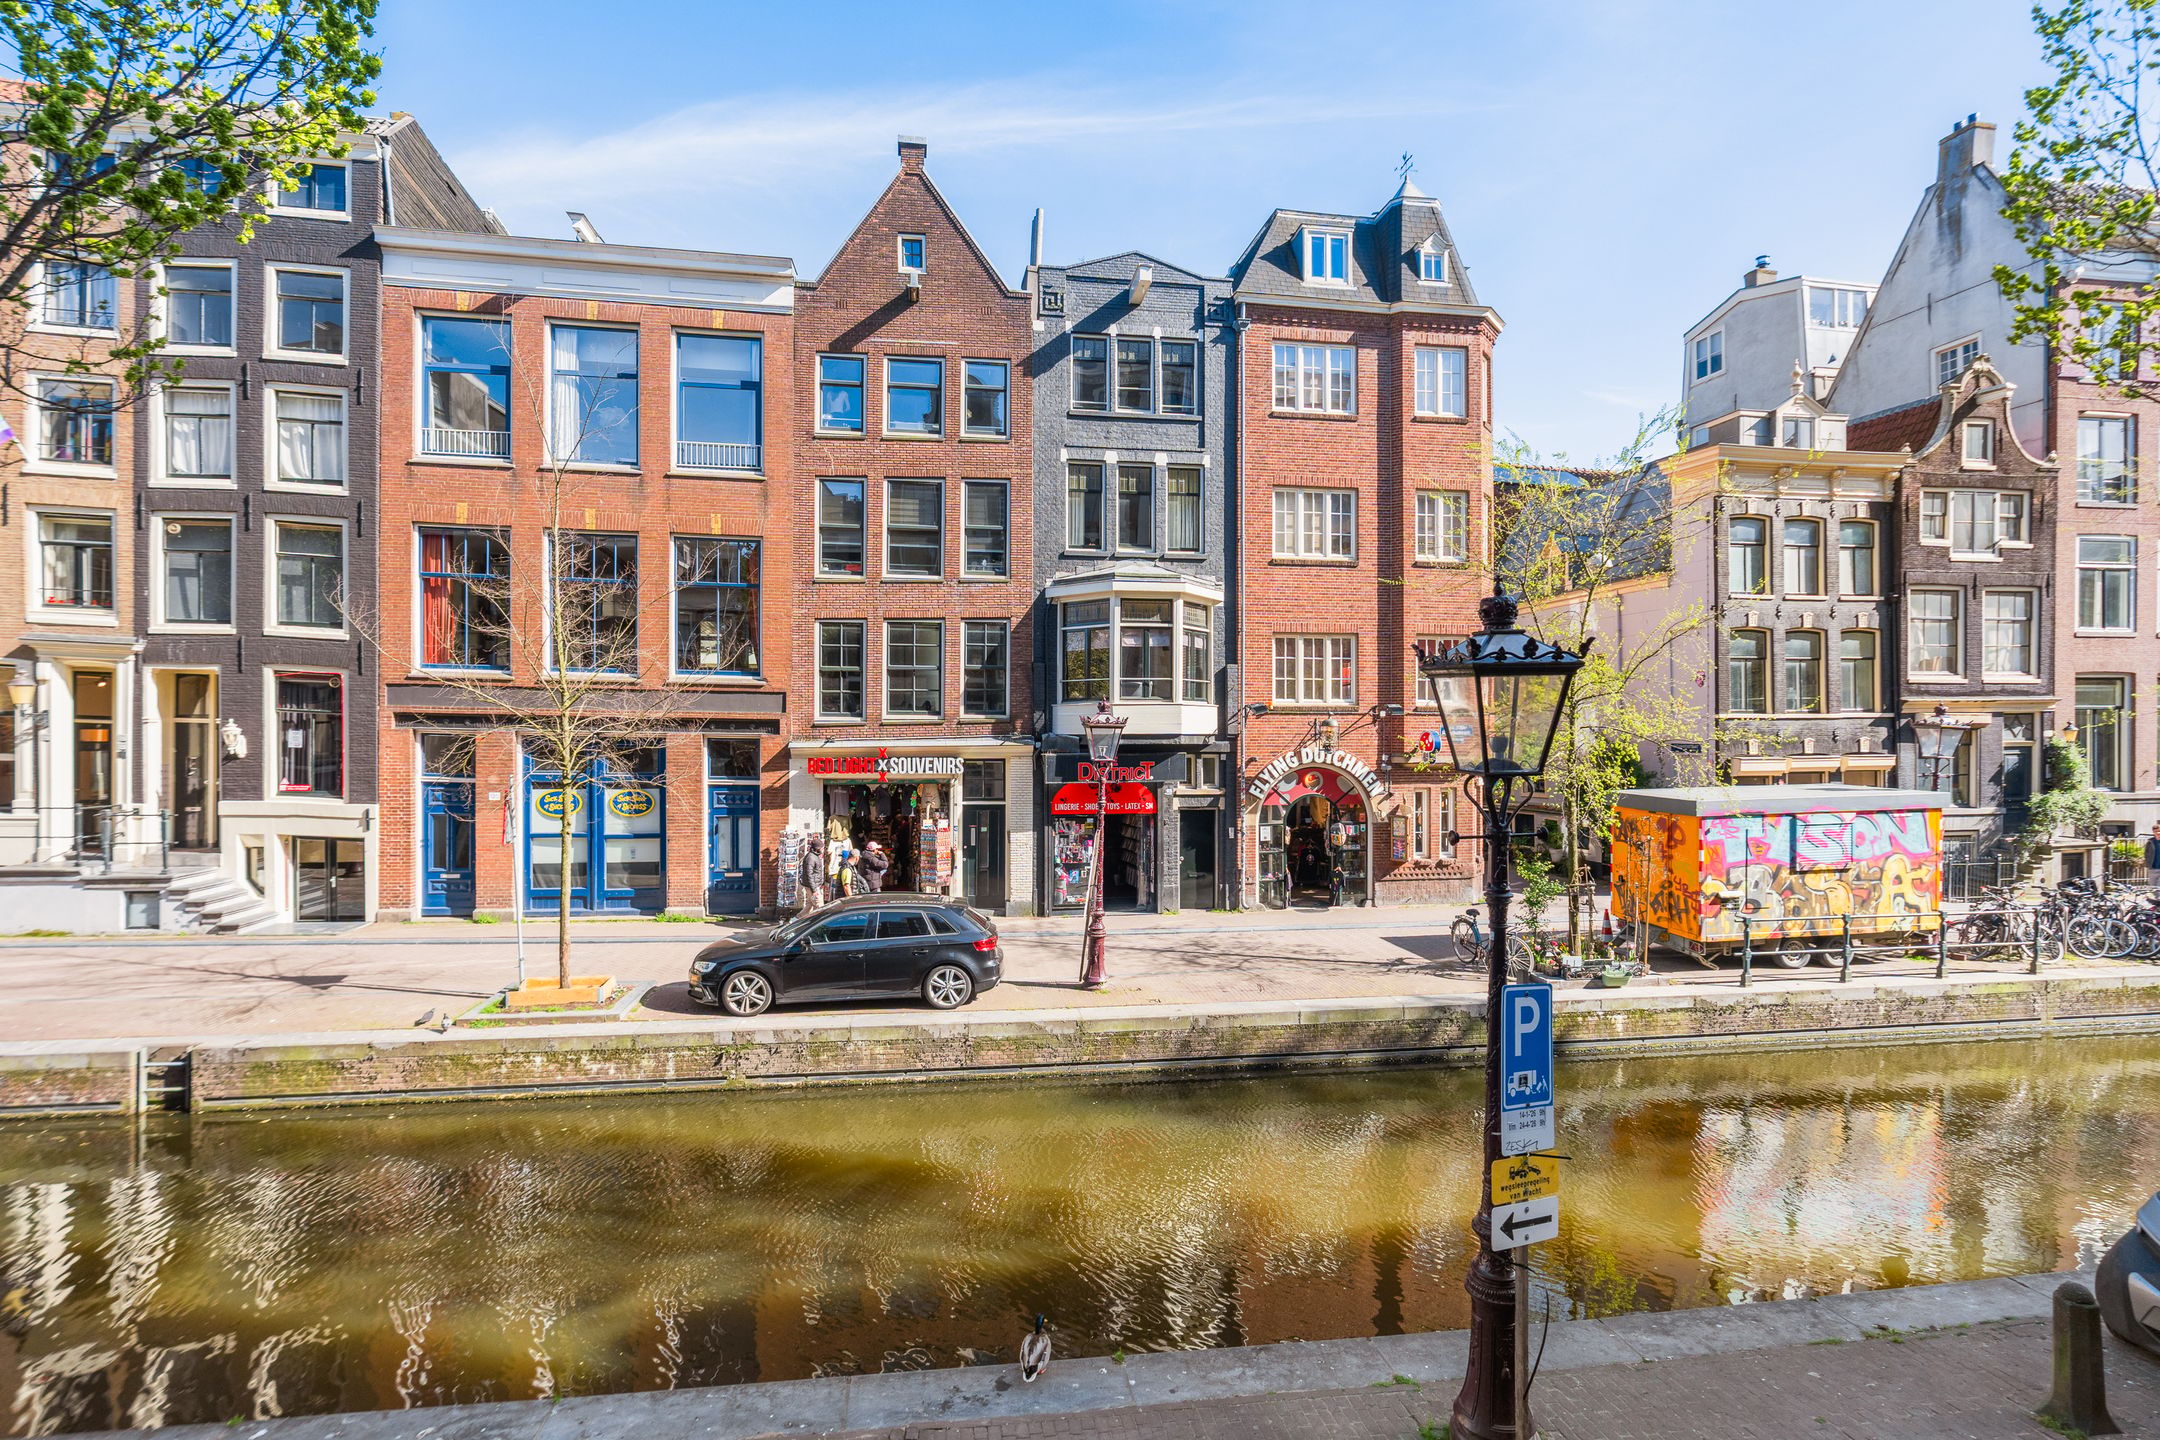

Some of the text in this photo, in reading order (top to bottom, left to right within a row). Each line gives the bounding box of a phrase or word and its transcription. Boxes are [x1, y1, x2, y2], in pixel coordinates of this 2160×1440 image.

[807, 757, 834, 774] RED
[837, 757, 876, 774] LIGHT
[889, 757, 965, 774] SOUVENIRS
[1248, 747, 1385, 799] FLYING DUTCHMEN
[1054, 803, 1080, 811] LINGERIE
[1084, 802, 1101, 811] SHOE
[1107, 802, 1120, 810] TOYS
[1124, 802, 1141, 810] LATEX
[1514, 996, 1541, 1057] P
[1510, 1192, 1521, 1200] van
